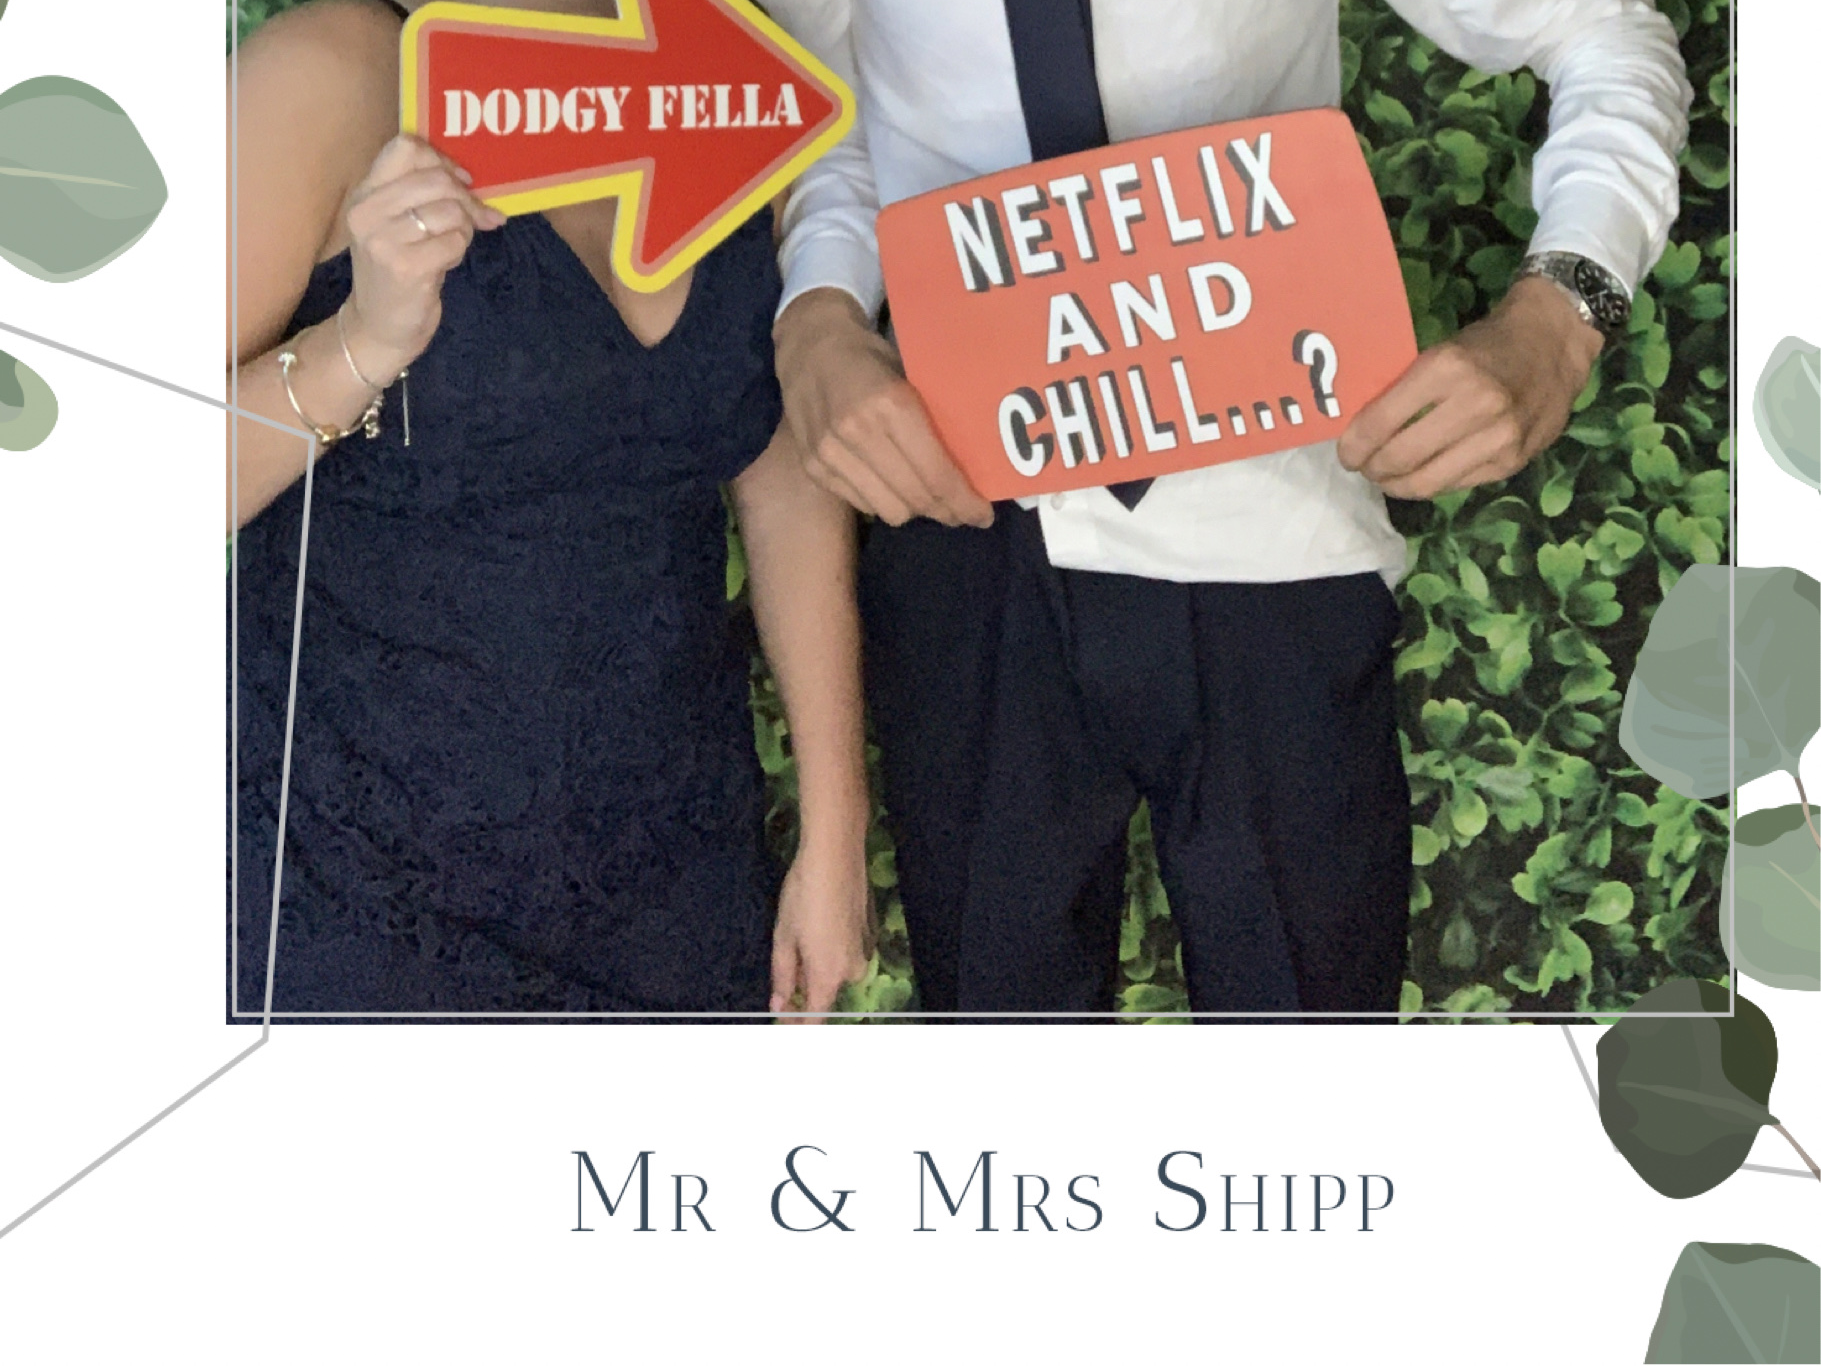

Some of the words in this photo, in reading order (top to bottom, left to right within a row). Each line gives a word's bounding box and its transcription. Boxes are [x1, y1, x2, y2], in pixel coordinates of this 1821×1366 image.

[443, 86, 631, 137] DODGY
[648, 83, 803, 130] FELLA
[944, 132, 1297, 292] NETFLIX
[1046, 261, 1252, 365] AND
[998, 329, 1341, 478] CHILL...?
